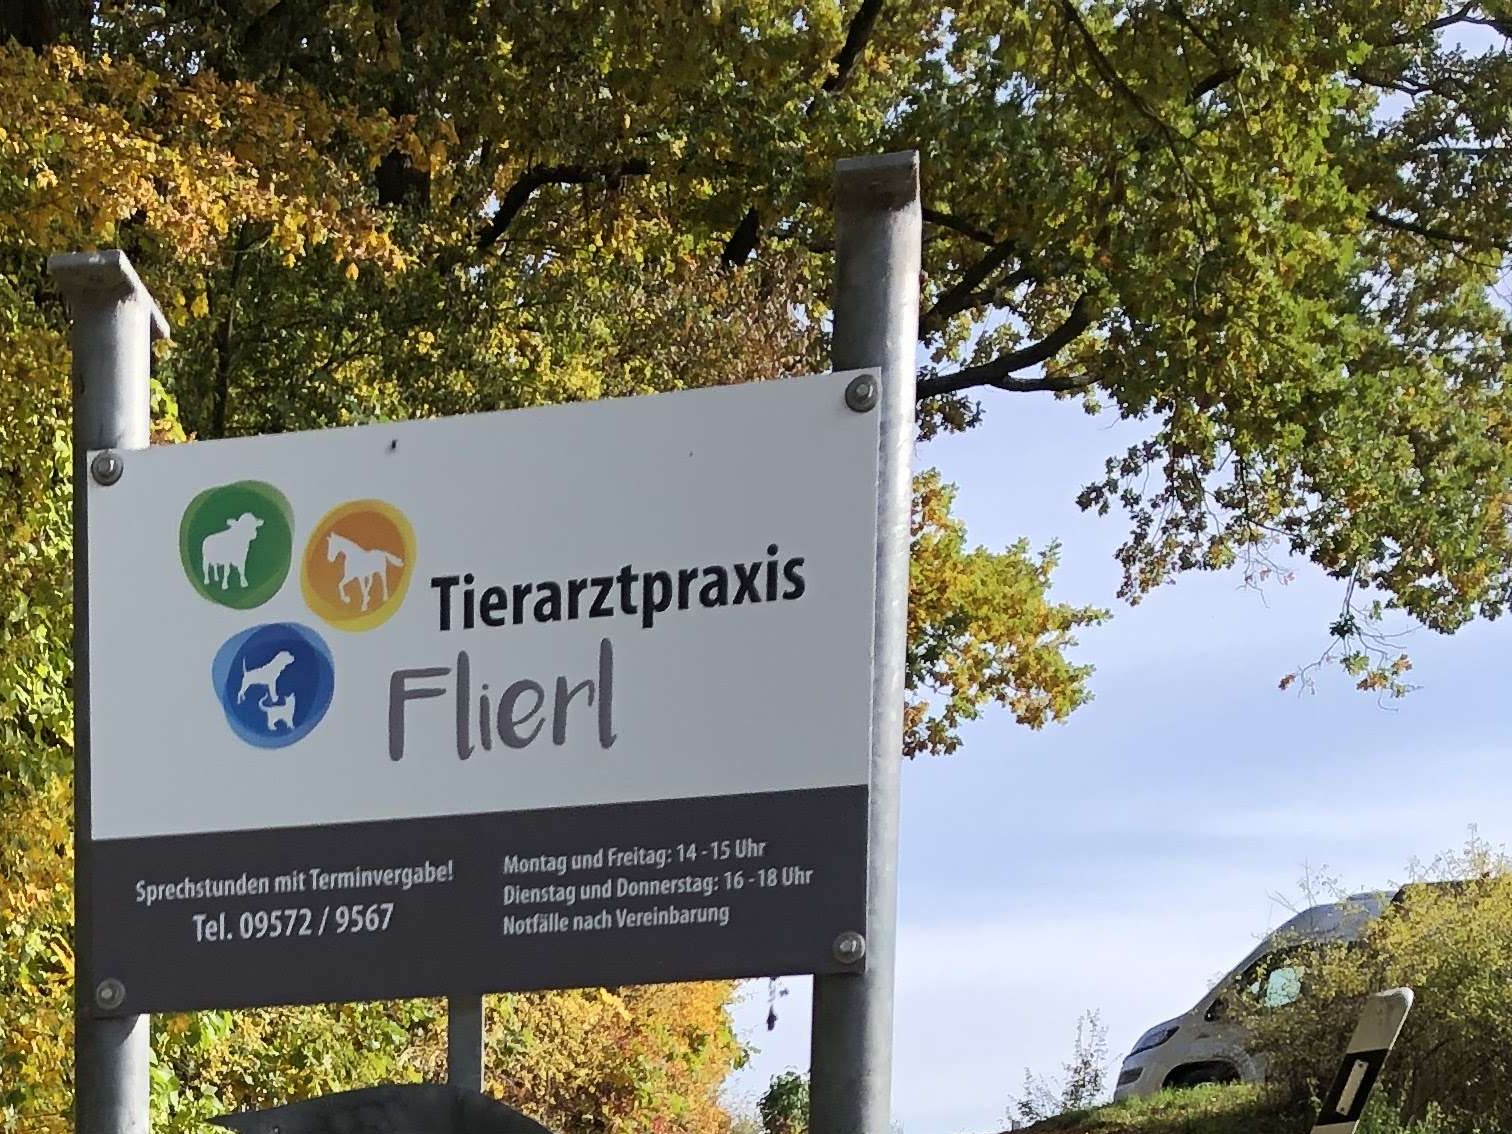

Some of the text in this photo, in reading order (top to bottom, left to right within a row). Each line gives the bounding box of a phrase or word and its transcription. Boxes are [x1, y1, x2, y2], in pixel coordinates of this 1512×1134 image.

[430, 543, 806, 632] Tierarztpraxis
[388, 637, 618, 762] Flierl
[502, 854, 568, 876] Montag
[571, 847, 604, 870] und
[607, 846, 672, 869] Freitag:
[676, 843, 697, 862] 14
[711, 840, 731, 860] 15
[735, 837, 767, 859] Uhr
[136, 859, 454, 907] Sprechstunden mit Terminvergabe!
[503, 884, 576, 906] Dienstag
[580, 878, 612, 900] und
[616, 874, 719, 898] Donnerstag:
[723, 870, 744, 890] 16
[758, 867, 778, 888] 18
[782, 865, 814, 886] Uhr
[192, 911, 233, 942] Tel.
[239, 908, 312, 939] 09572
[335, 902, 394, 934] 9567
[503, 904, 730, 936] Notfälle nach Vereinbarung
